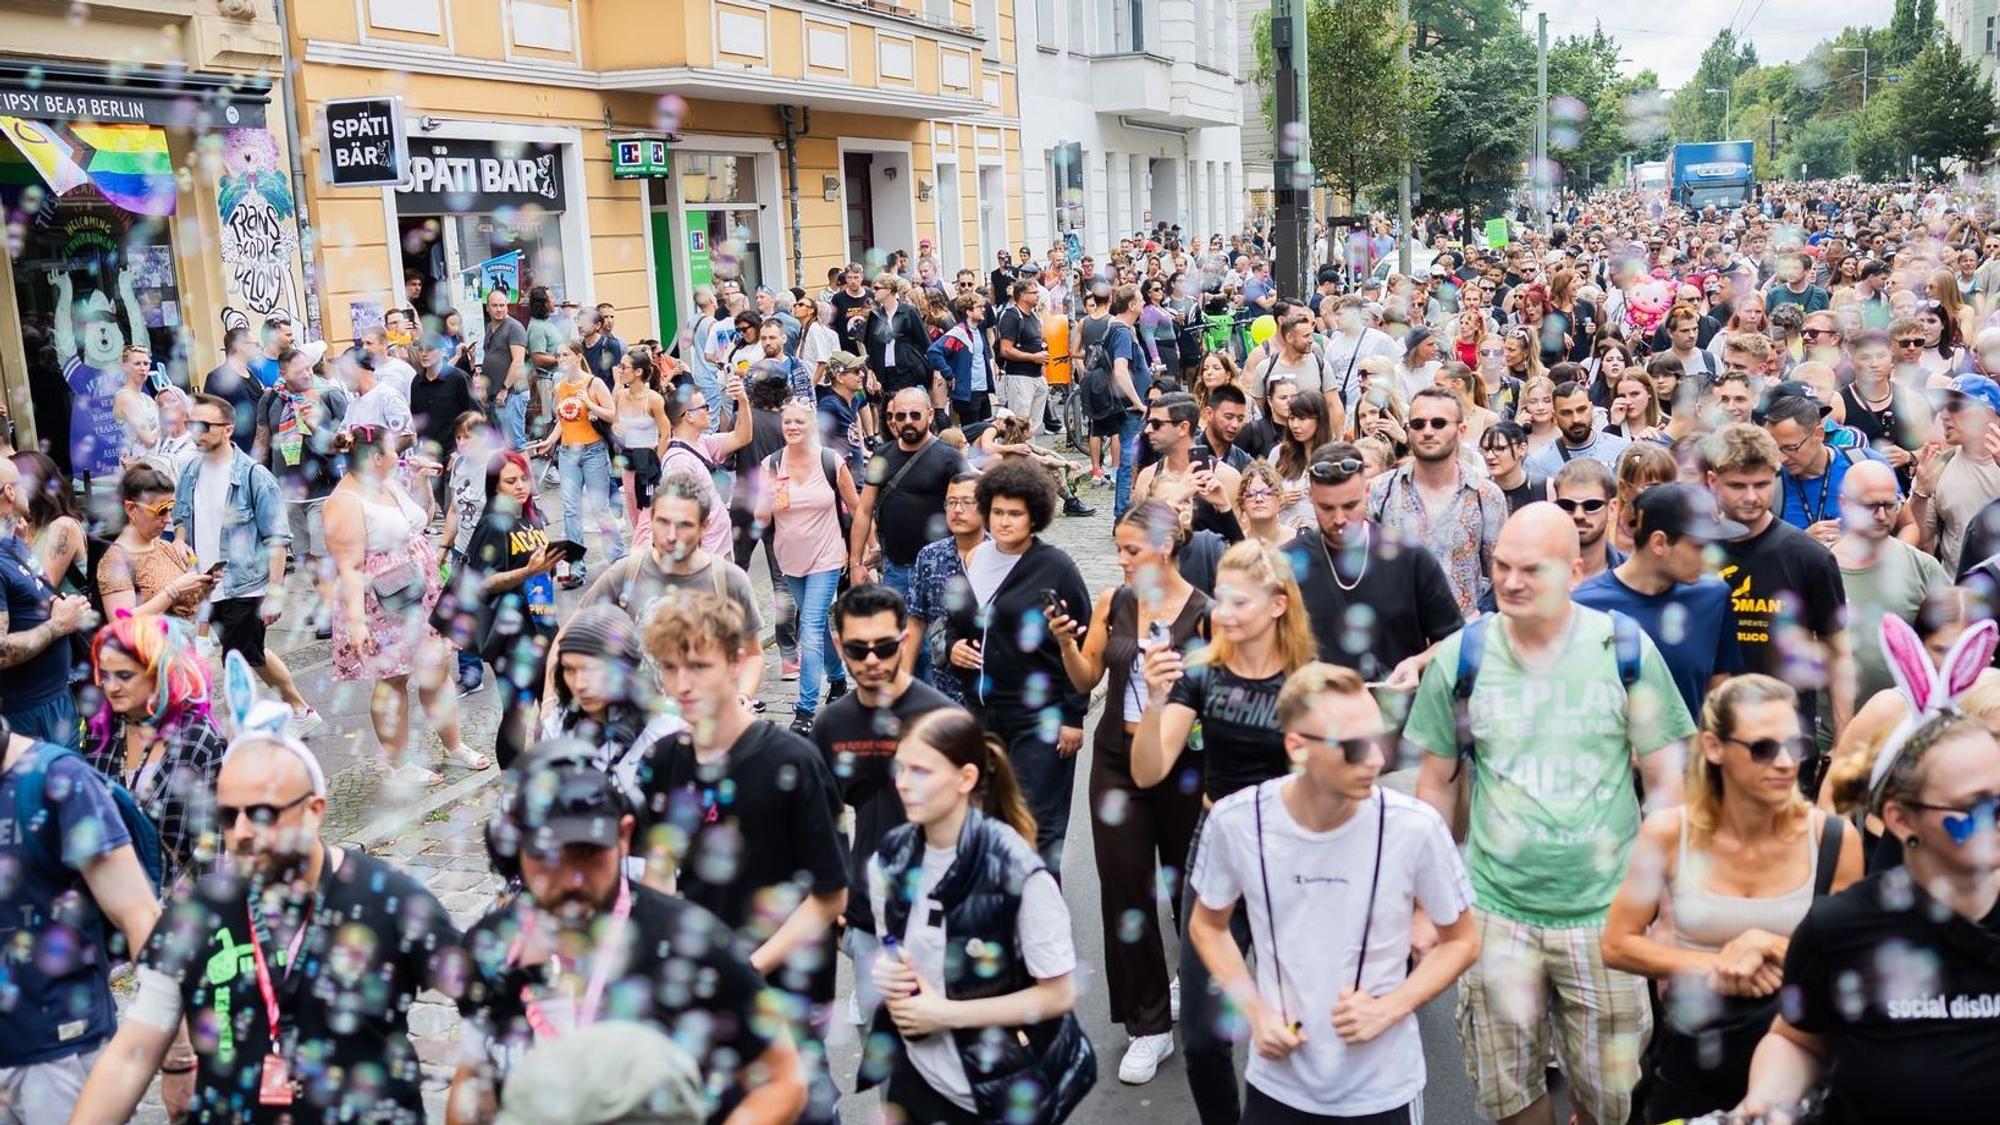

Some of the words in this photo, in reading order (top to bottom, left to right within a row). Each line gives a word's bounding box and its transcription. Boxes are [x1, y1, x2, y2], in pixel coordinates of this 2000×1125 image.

[90, 99, 144, 118] BERLIN
[332, 112, 389, 139] SPÄTI
[336, 142, 379, 167] BÄR
[480, 150, 539, 192] BÄR
[229, 203, 281, 242] TRANS
[1887, 993, 1949, 1019] social
